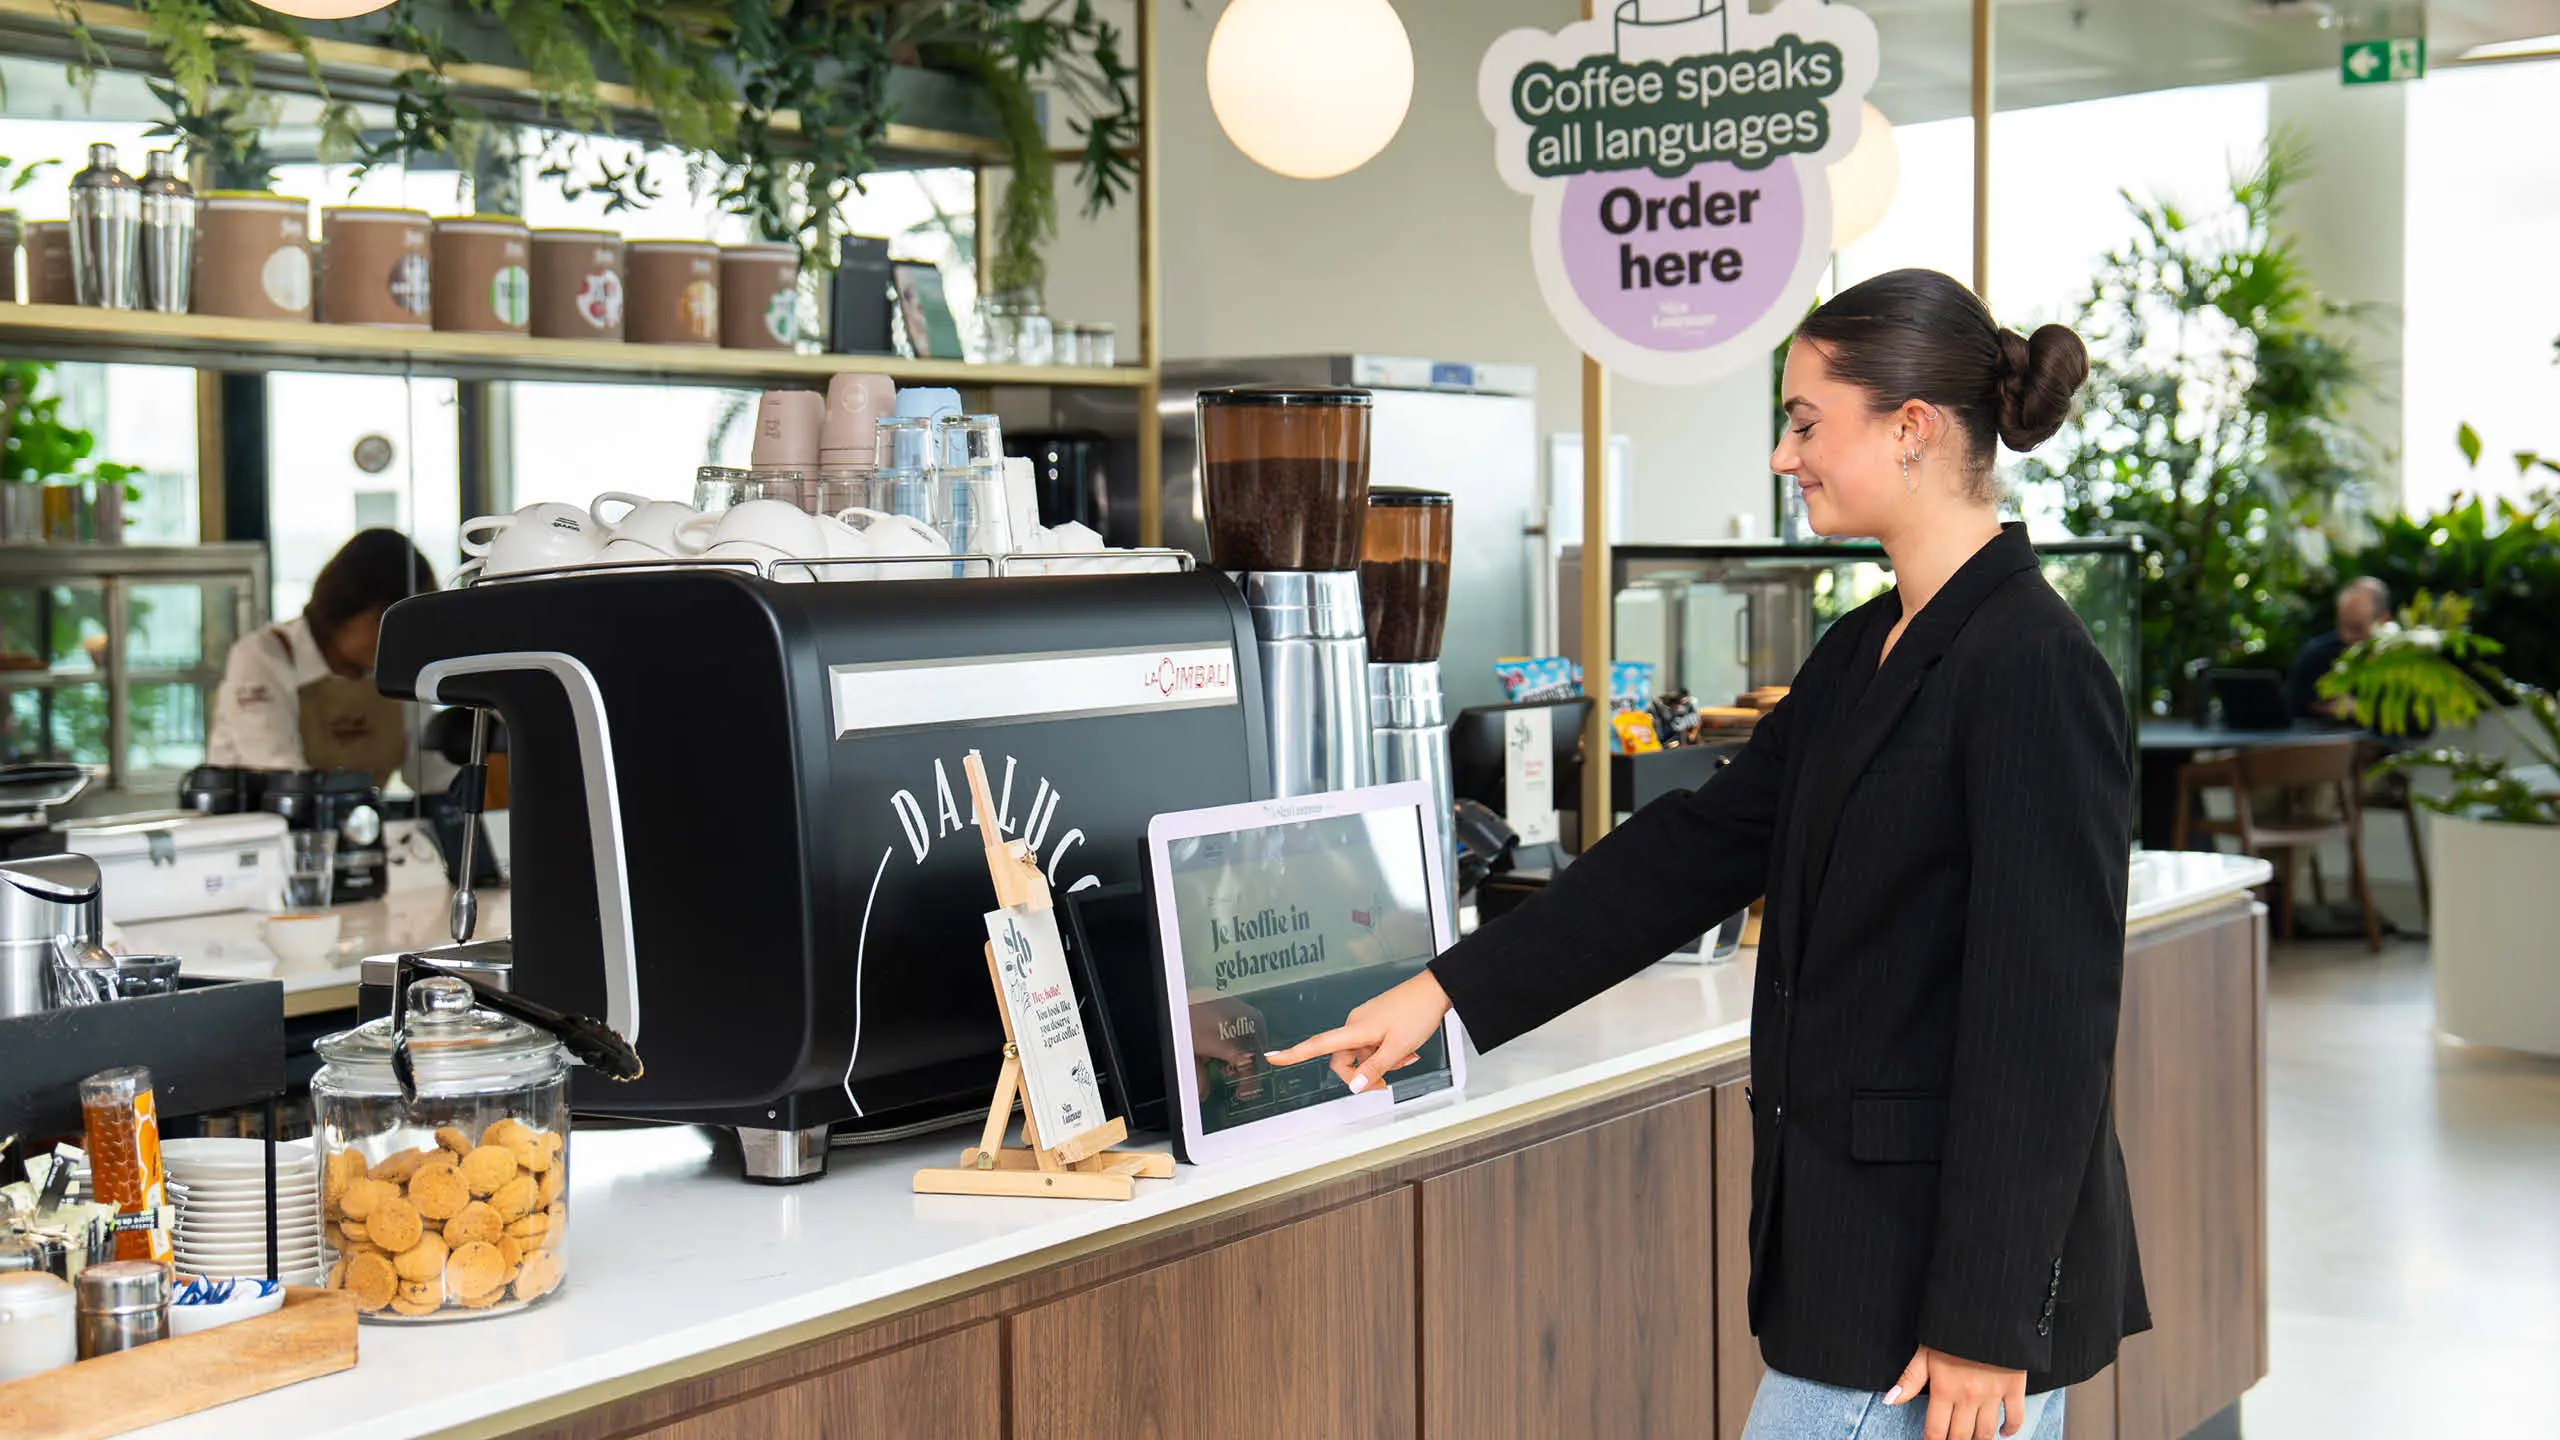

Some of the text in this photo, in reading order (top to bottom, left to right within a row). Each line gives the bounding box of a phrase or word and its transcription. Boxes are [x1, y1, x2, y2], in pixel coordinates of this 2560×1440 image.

[1520, 46, 1834, 117] Coffee speaks
[1536, 108, 1820, 167] all languages
[1599, 181, 1762, 237] Order
[1619, 243, 1744, 291] here
[1210, 904, 1311, 953] Je koffie in
[1215, 934, 1326, 992] gebarentaal
[1035, 1000, 1073, 1022] You look like
[1039, 1015, 1072, 1037] you deserve
[1218, 1016, 1257, 1042] Koffie
[1047, 1031, 1062, 1050] great
[1060, 1022, 1081, 1042] coffee?
